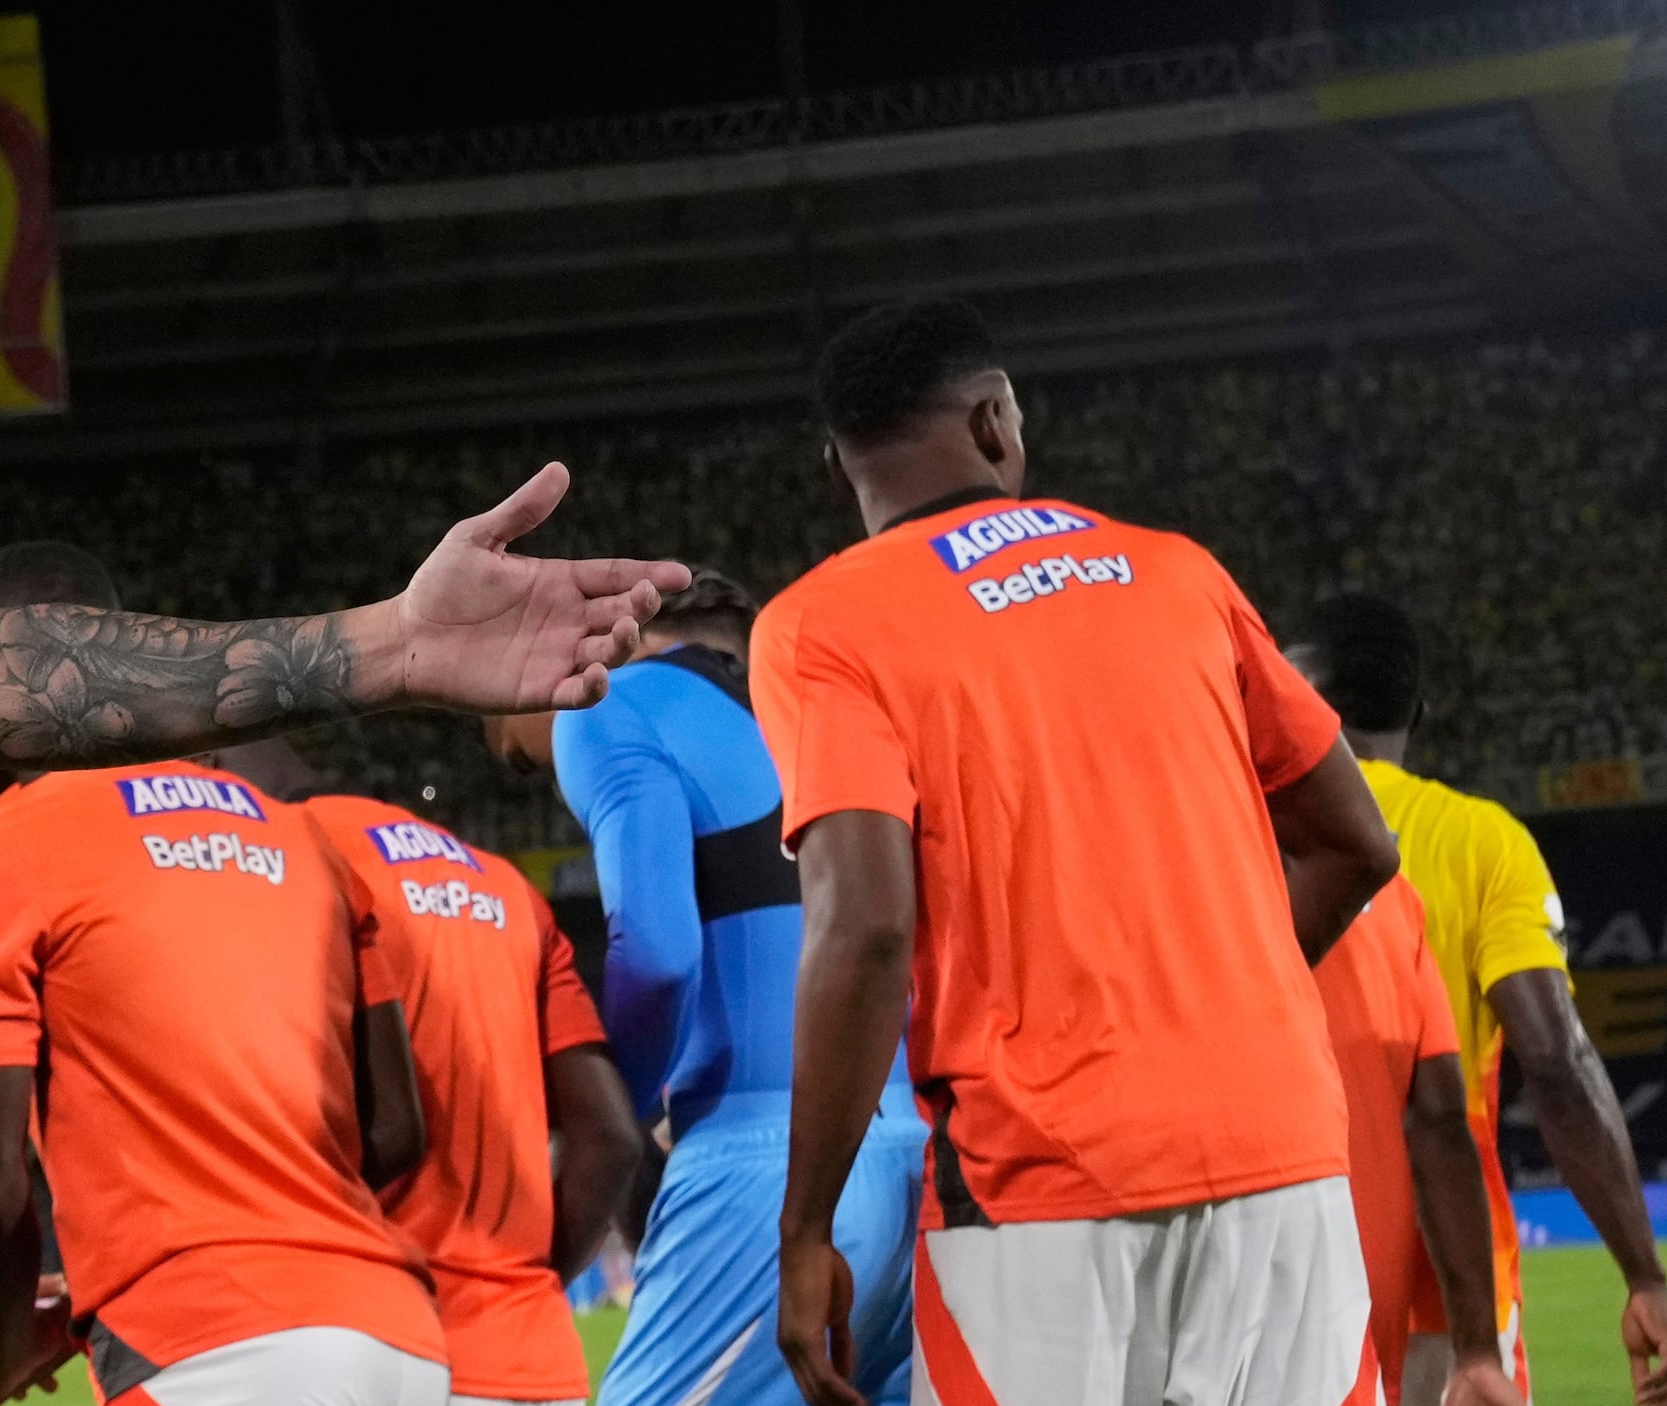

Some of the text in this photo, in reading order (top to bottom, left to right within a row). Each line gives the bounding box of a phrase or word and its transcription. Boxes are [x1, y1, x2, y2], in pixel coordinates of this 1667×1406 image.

[945, 508, 1090, 571] AGUILA
[967, 553, 1134, 614] BetPlay
[130, 775, 260, 818] AGUILA
[141, 832, 285, 885] BetPlay
